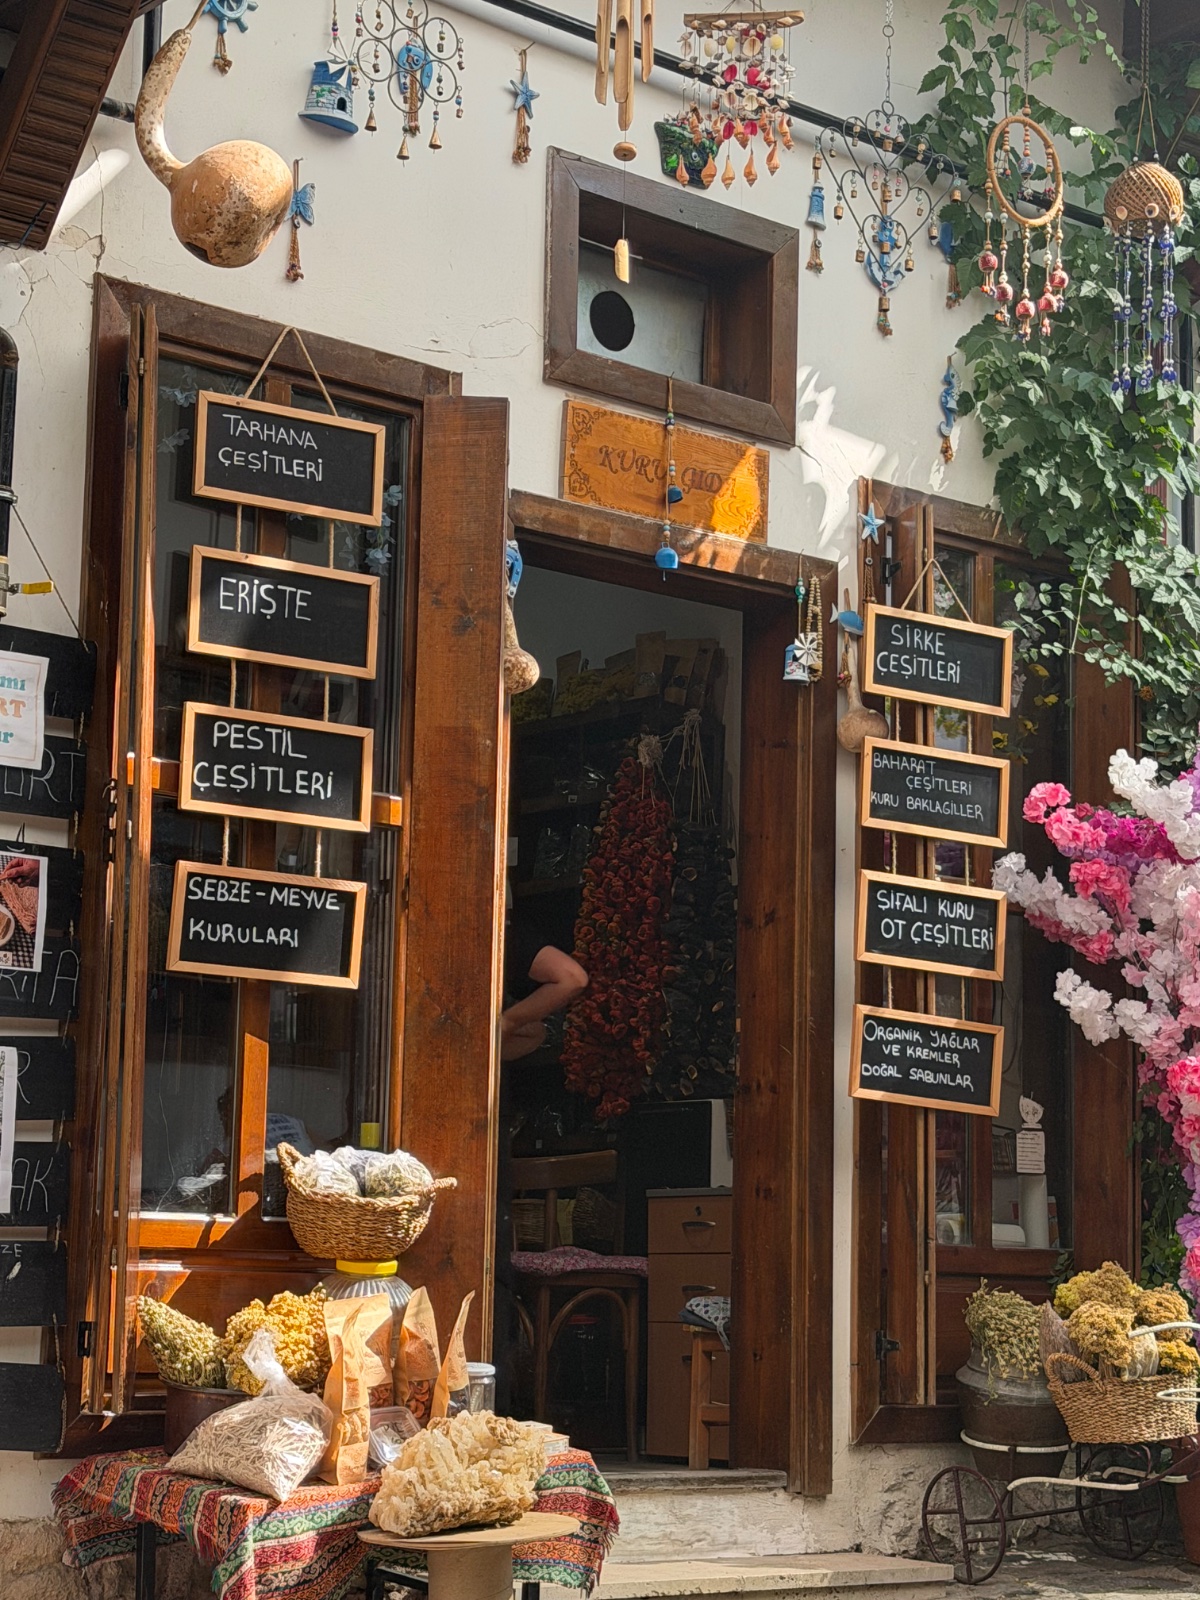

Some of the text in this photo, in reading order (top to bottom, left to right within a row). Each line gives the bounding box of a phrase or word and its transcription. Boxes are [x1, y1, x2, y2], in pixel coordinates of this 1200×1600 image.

[222, 413, 318, 450] TARHANA
[217, 447, 323, 482] ÇEŞİTLERİ
[219, 576, 312, 621] ERİŞTE
[890, 623, 946, 656] SİRKE
[876, 651, 961, 684] ÇEŞİTLERİ
[873, 752, 936, 775] BAHARAT
[193, 762, 334, 799] ÇEŞİTLERİ
[905, 775, 972, 796] ÇEŞİTLERİ
[870, 790, 984, 822] KURU BAKLAGİLLER
[188, 876, 252, 904] SEBZE
[269, 886, 340, 911] MEYVE
[876, 889, 975, 921] ŞİFALI KURU
[189, 917, 299, 948] KURULARI
[881, 918, 994, 951] OT ÇEŞİTLERİ
[882, 1044, 960, 1068] VE KREMLER
[930, 1029, 980, 1053] YAĞLAR
[861, 1063, 974, 1092] DOĞAL SABUNLAR
